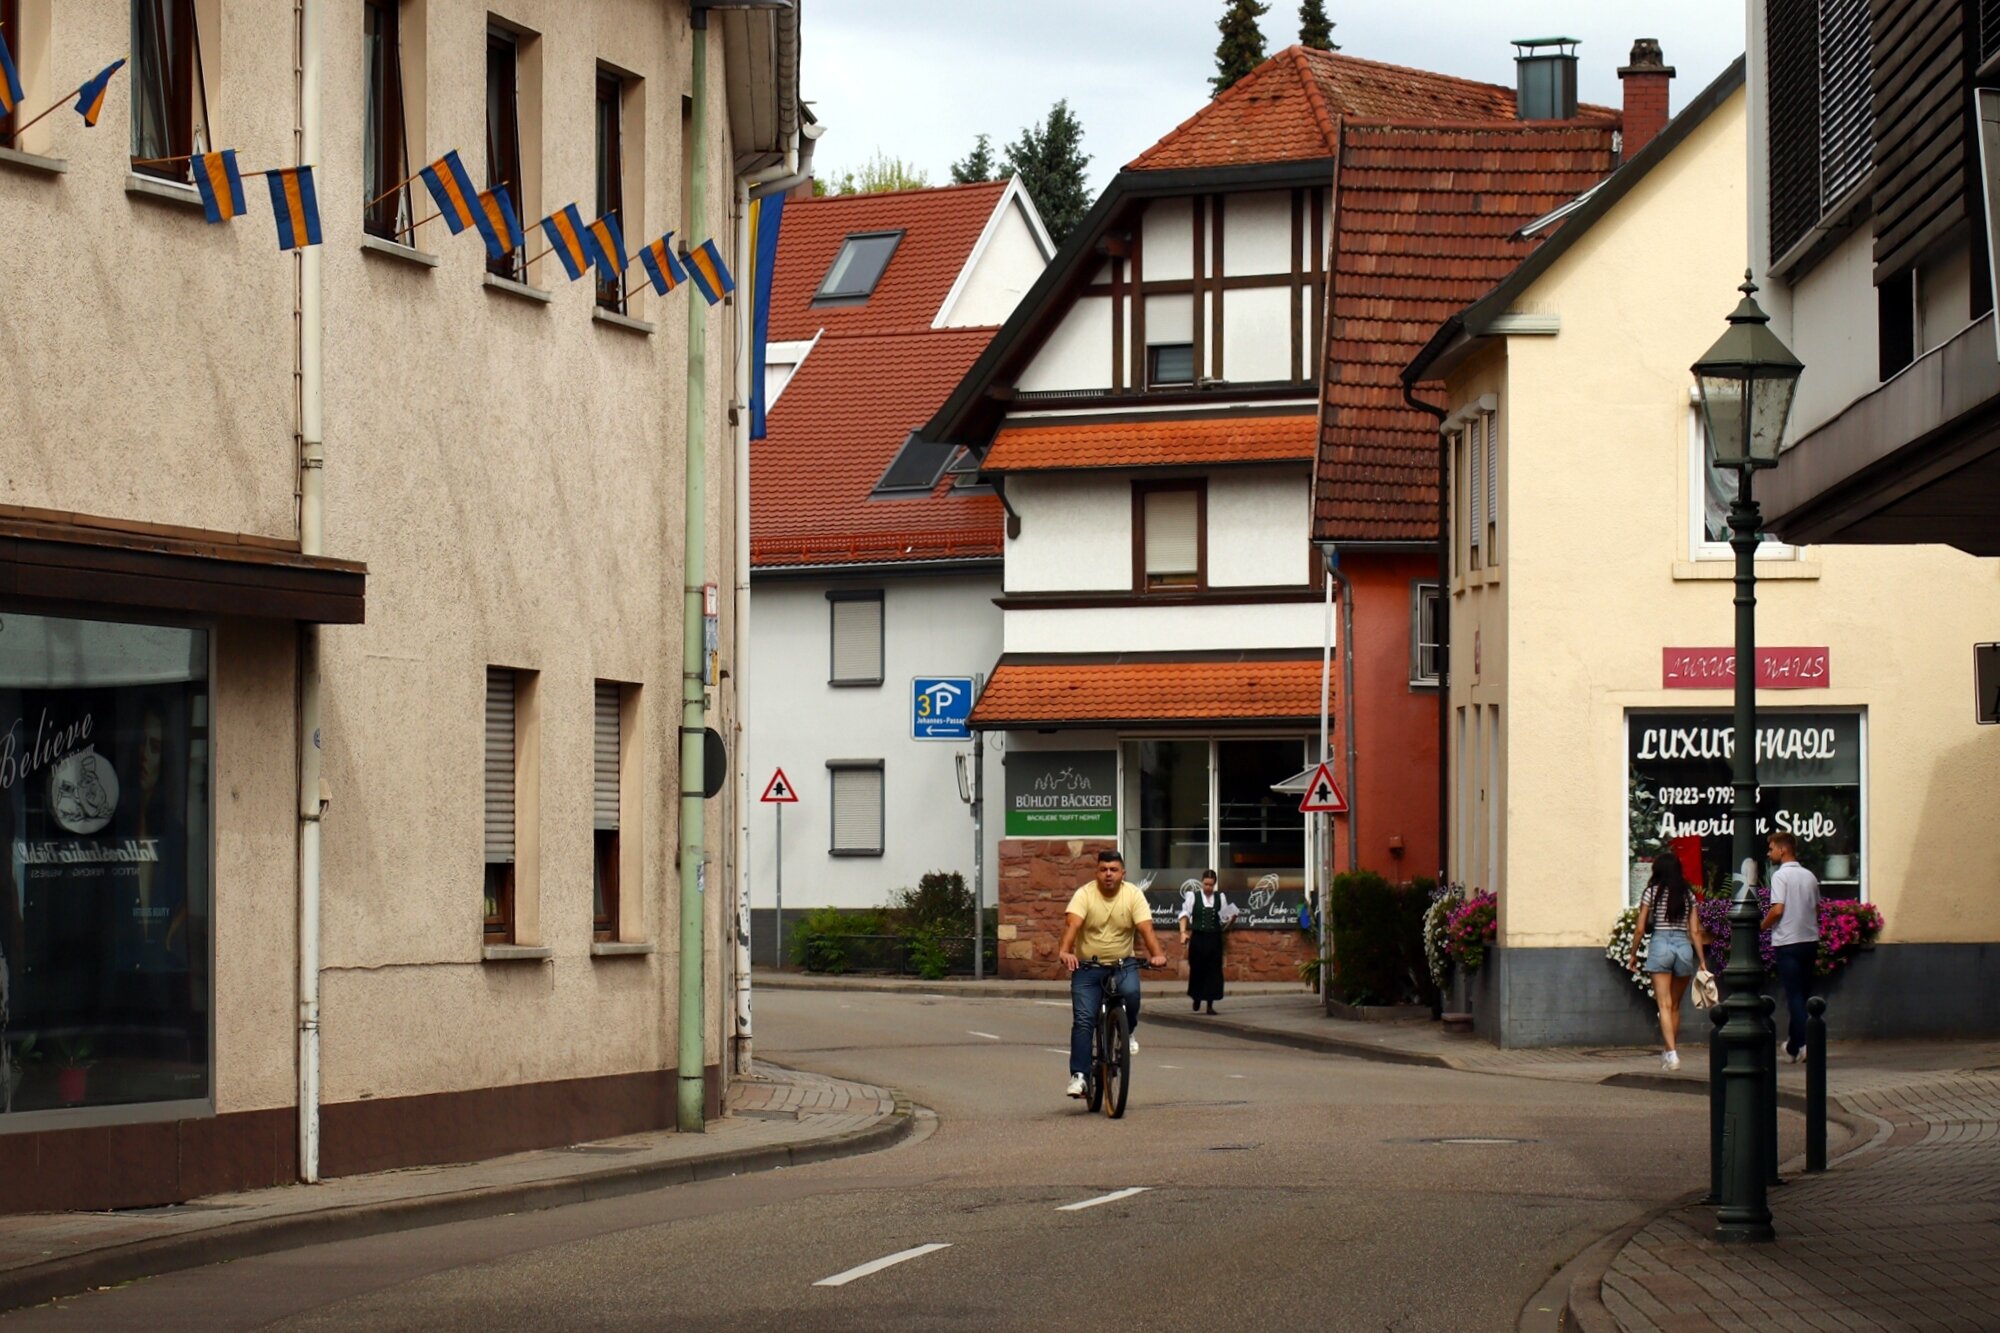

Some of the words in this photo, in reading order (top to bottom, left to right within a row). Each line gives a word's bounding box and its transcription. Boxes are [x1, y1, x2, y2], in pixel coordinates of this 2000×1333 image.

[1668, 656, 1735, 678] LUXUR
[1763, 656, 1825, 679] NAILS
[917, 694, 931, 717] 3
[935, 691, 953, 715] P
[917, 716, 966, 727] Johannes-Passag
[1015, 793, 1059, 808] BÜHLOT
[1061, 793, 1112, 808] BÄCKEREI
[1658, 811, 1770, 839] Americn
[1774, 809, 1837, 842] Style
